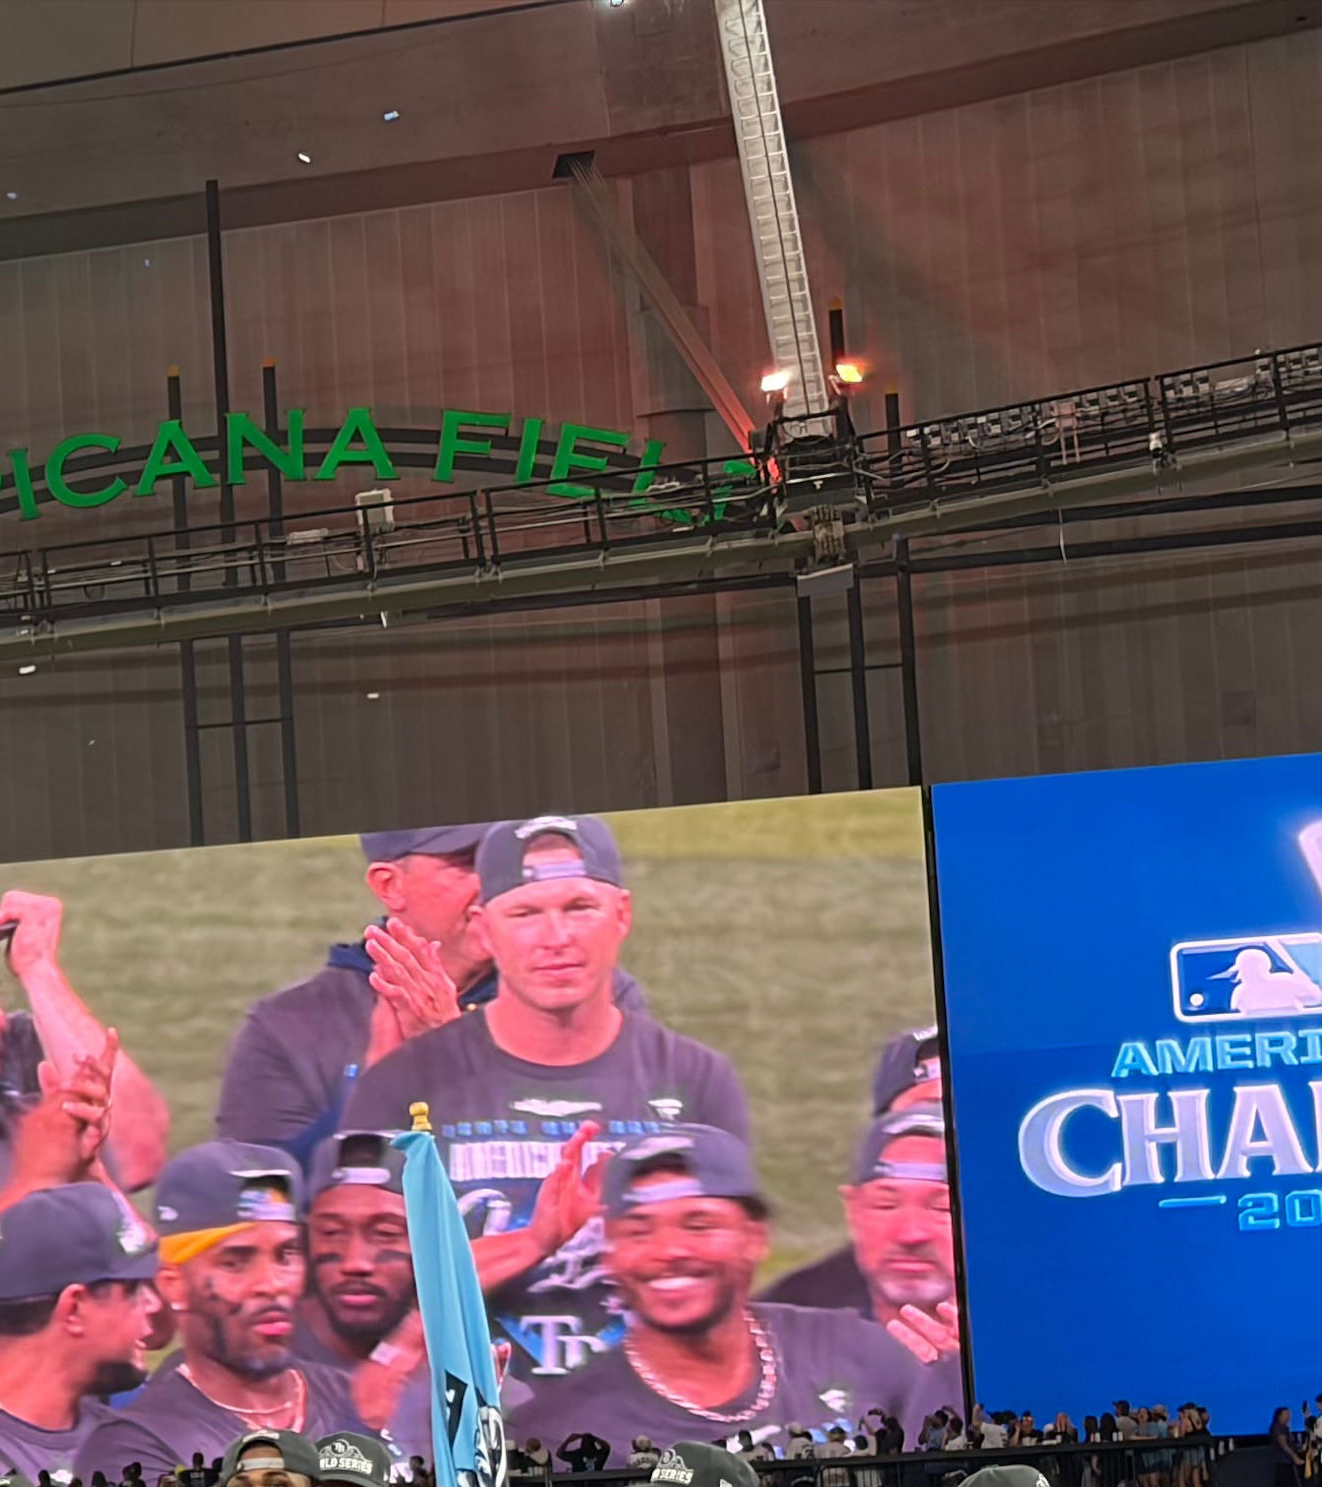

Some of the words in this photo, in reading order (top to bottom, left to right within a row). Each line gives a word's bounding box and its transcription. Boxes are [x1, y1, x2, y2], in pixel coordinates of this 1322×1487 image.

[1110, 1028, 1322, 1078] AMERI
[1238, 1188, 1322, 1231] 20
[338, 1459, 373, 1475] SERIES
